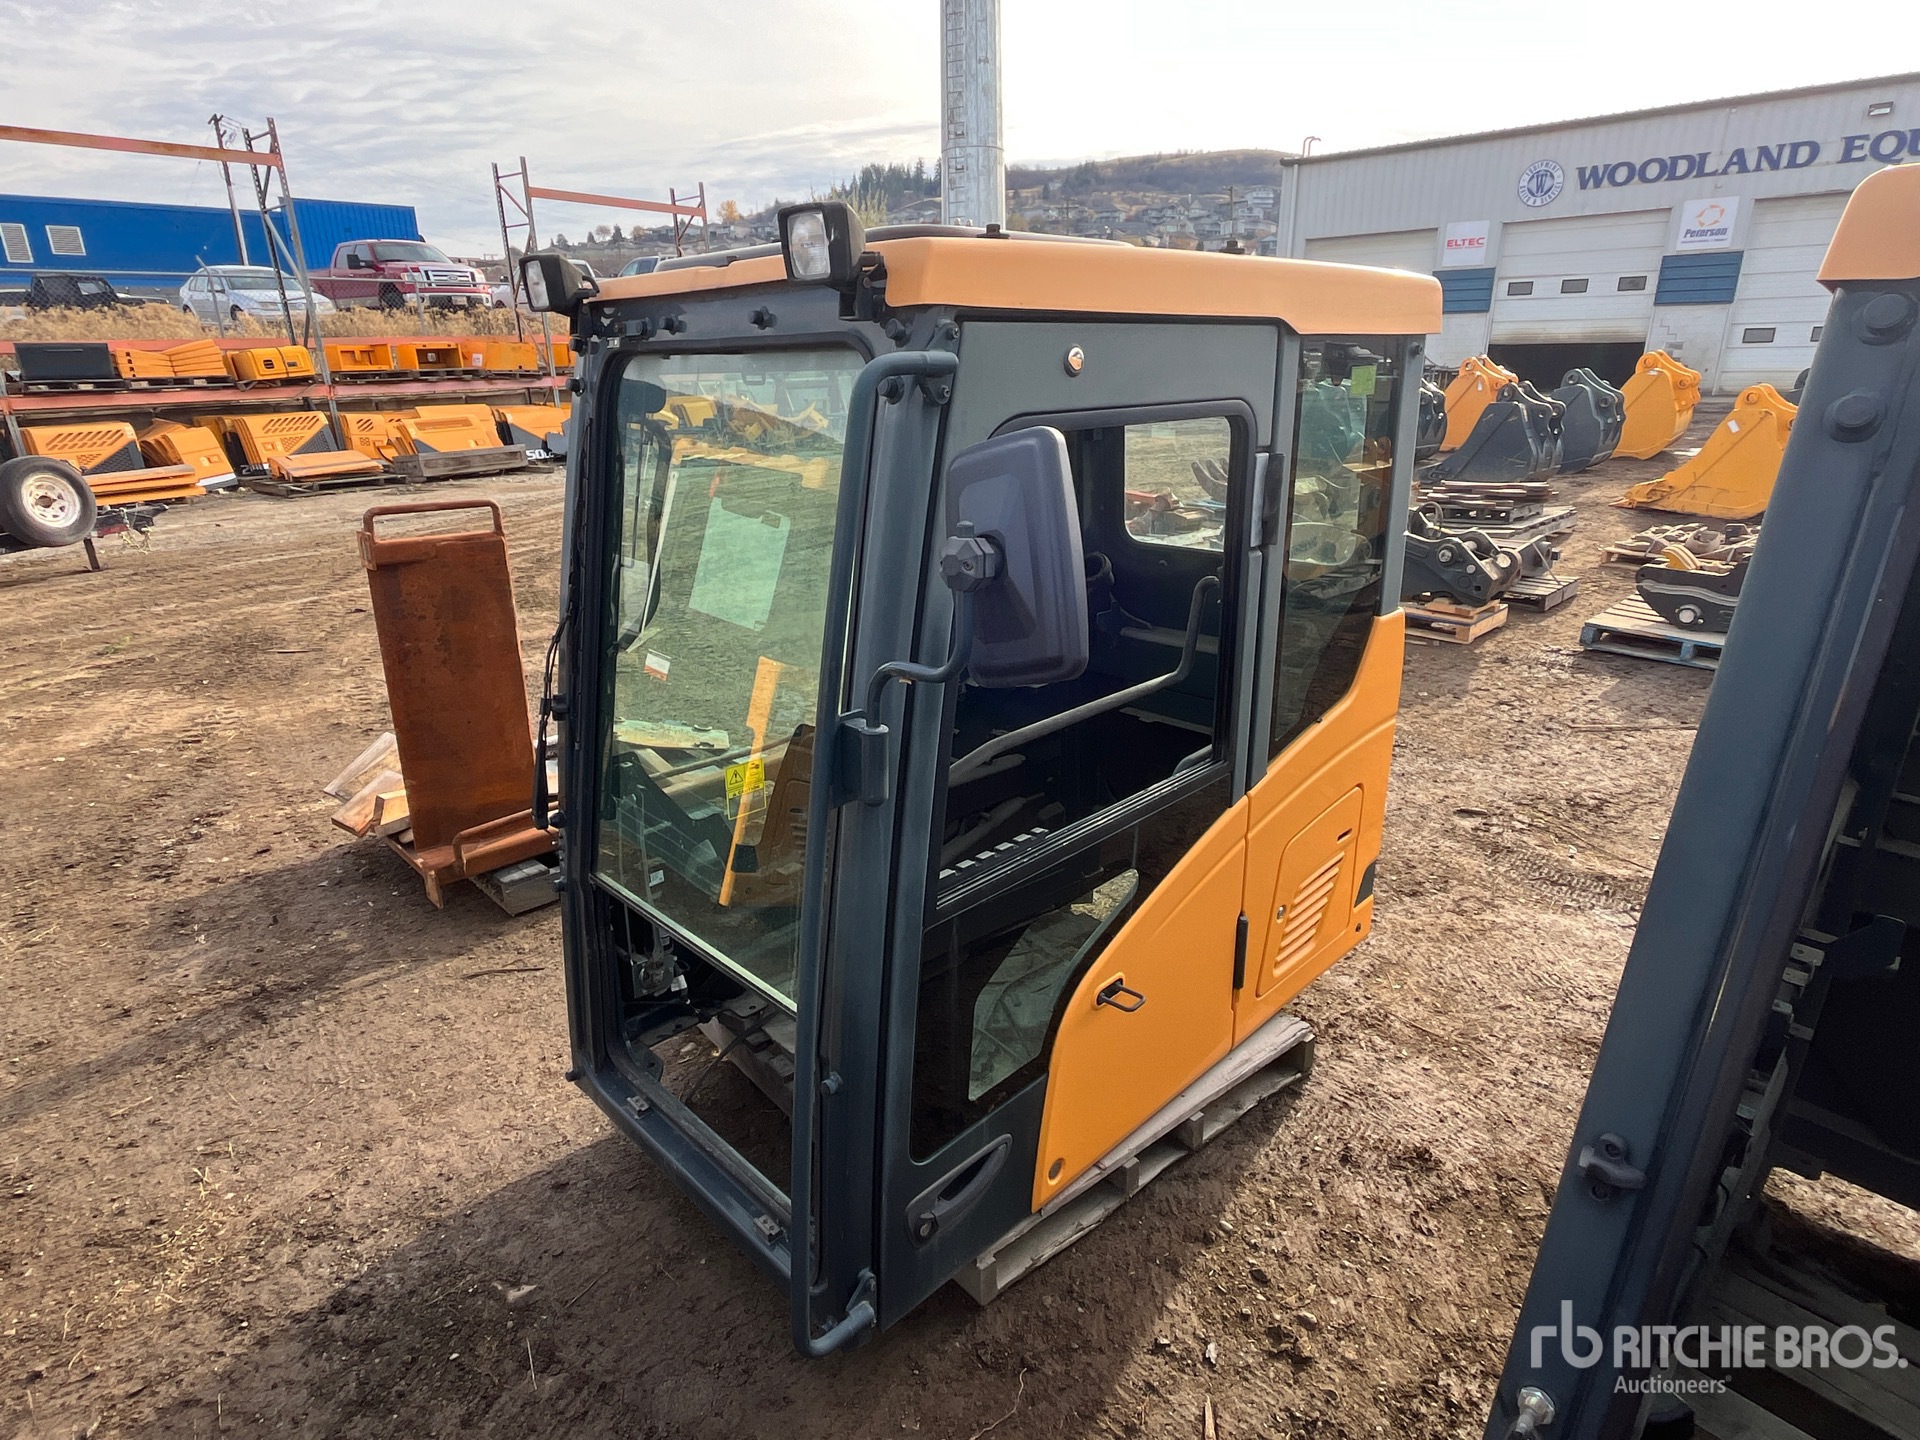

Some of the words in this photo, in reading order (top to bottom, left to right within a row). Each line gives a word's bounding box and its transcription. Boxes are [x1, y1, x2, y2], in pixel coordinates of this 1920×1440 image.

[1576, 140, 1821, 191] WOODLAND
[1535, 173, 1548, 194] W
[1683, 227, 1728, 239] Peterson
[1446, 237, 1485, 248] ELTEC
